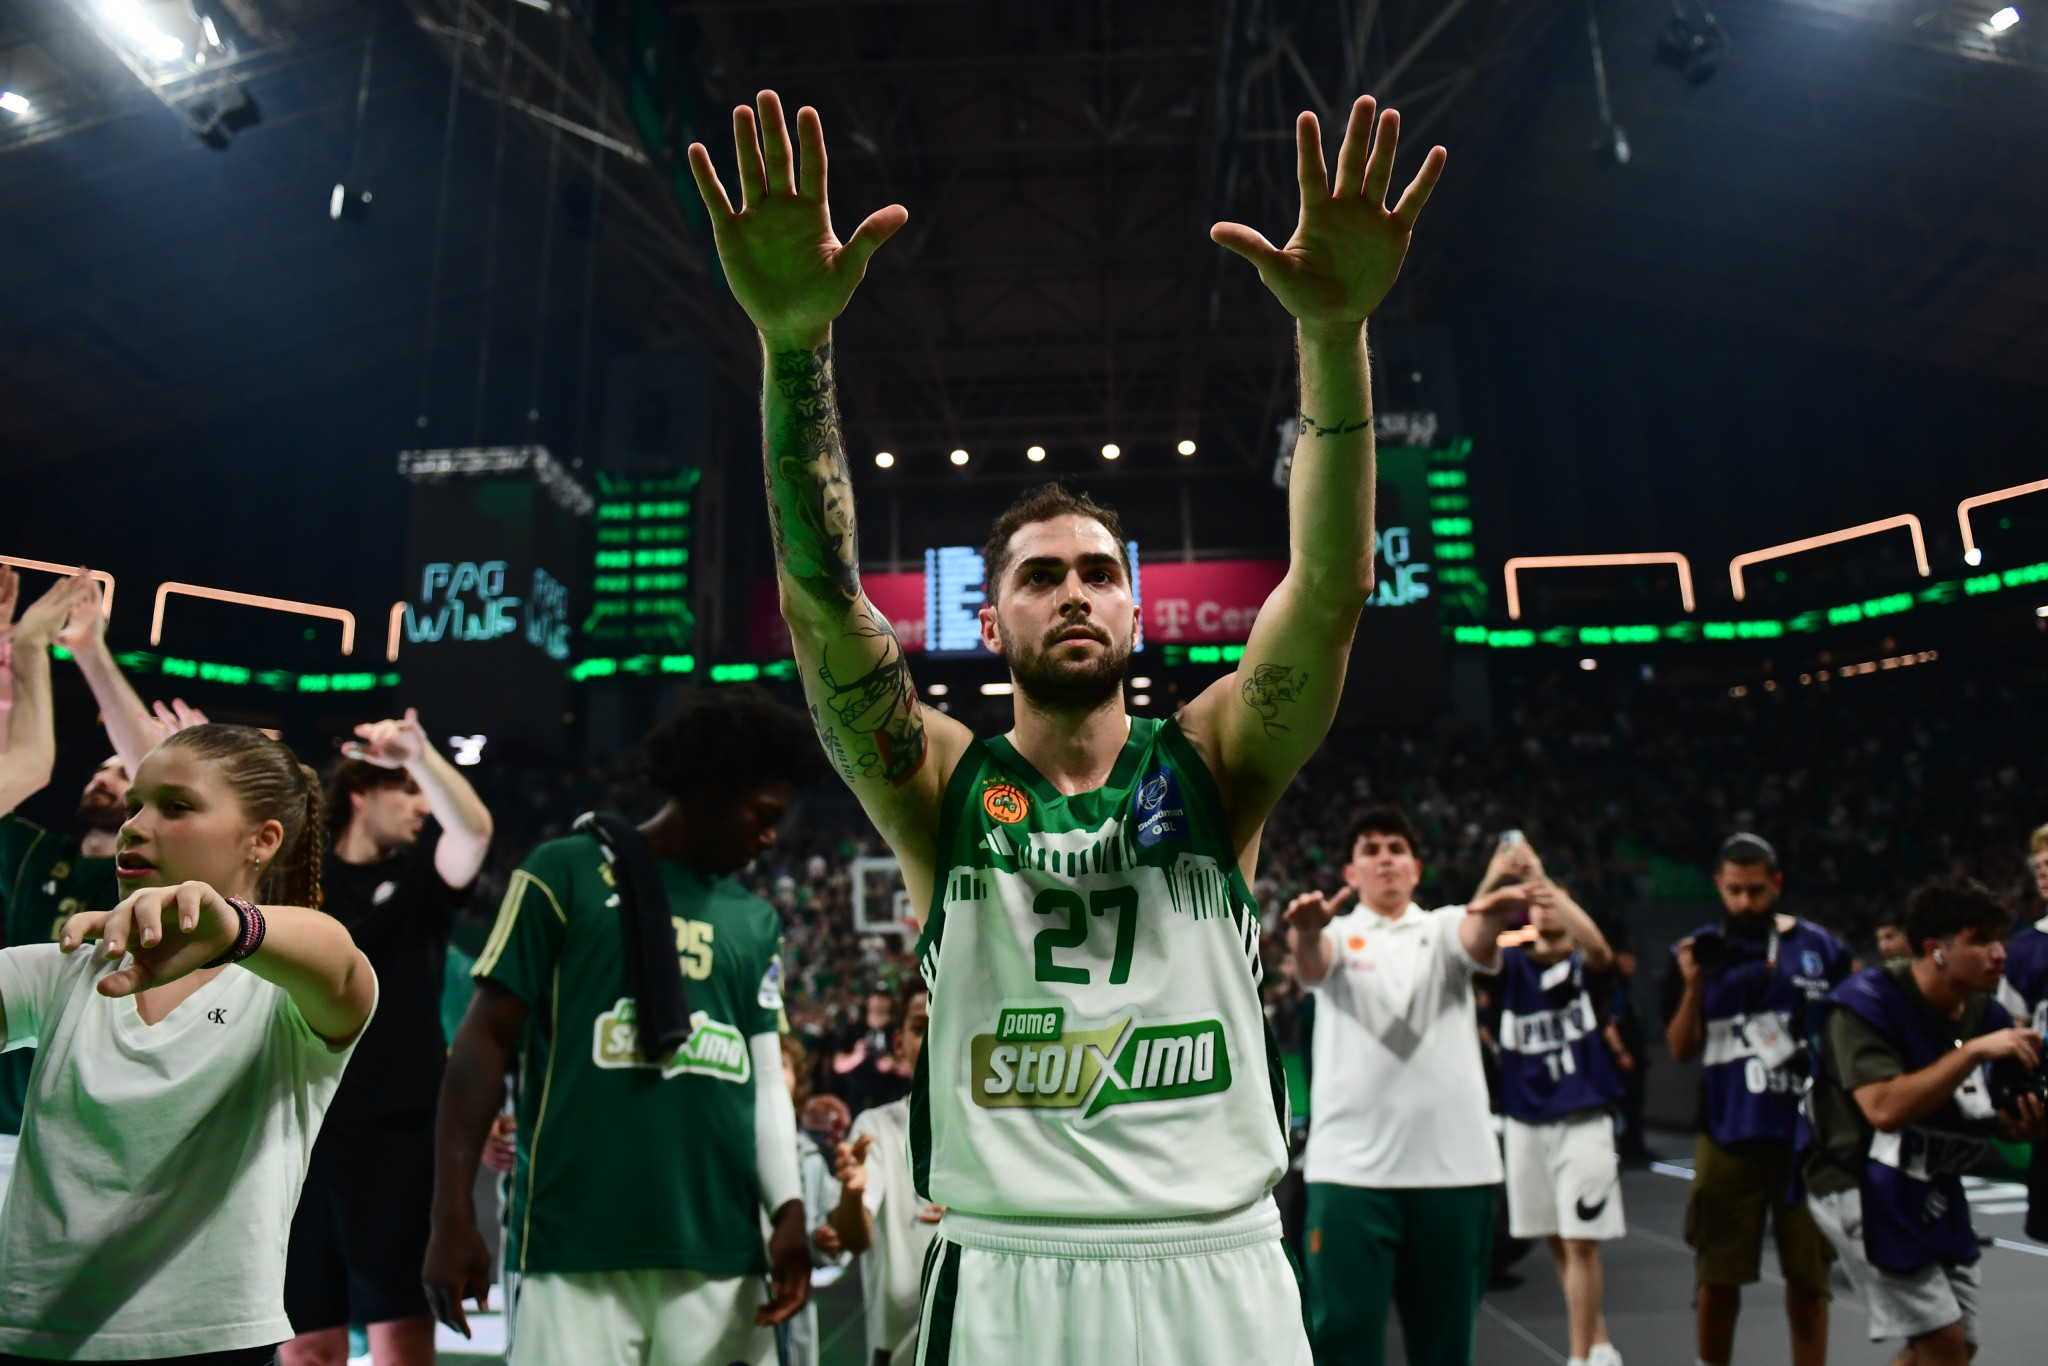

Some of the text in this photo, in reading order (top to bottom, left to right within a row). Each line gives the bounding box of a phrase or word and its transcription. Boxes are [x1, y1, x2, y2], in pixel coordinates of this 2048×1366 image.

[1152, 822, 1177, 836] GBL
[1032, 885, 1139, 985] 27
[1002, 1012, 1057, 1038] pame
